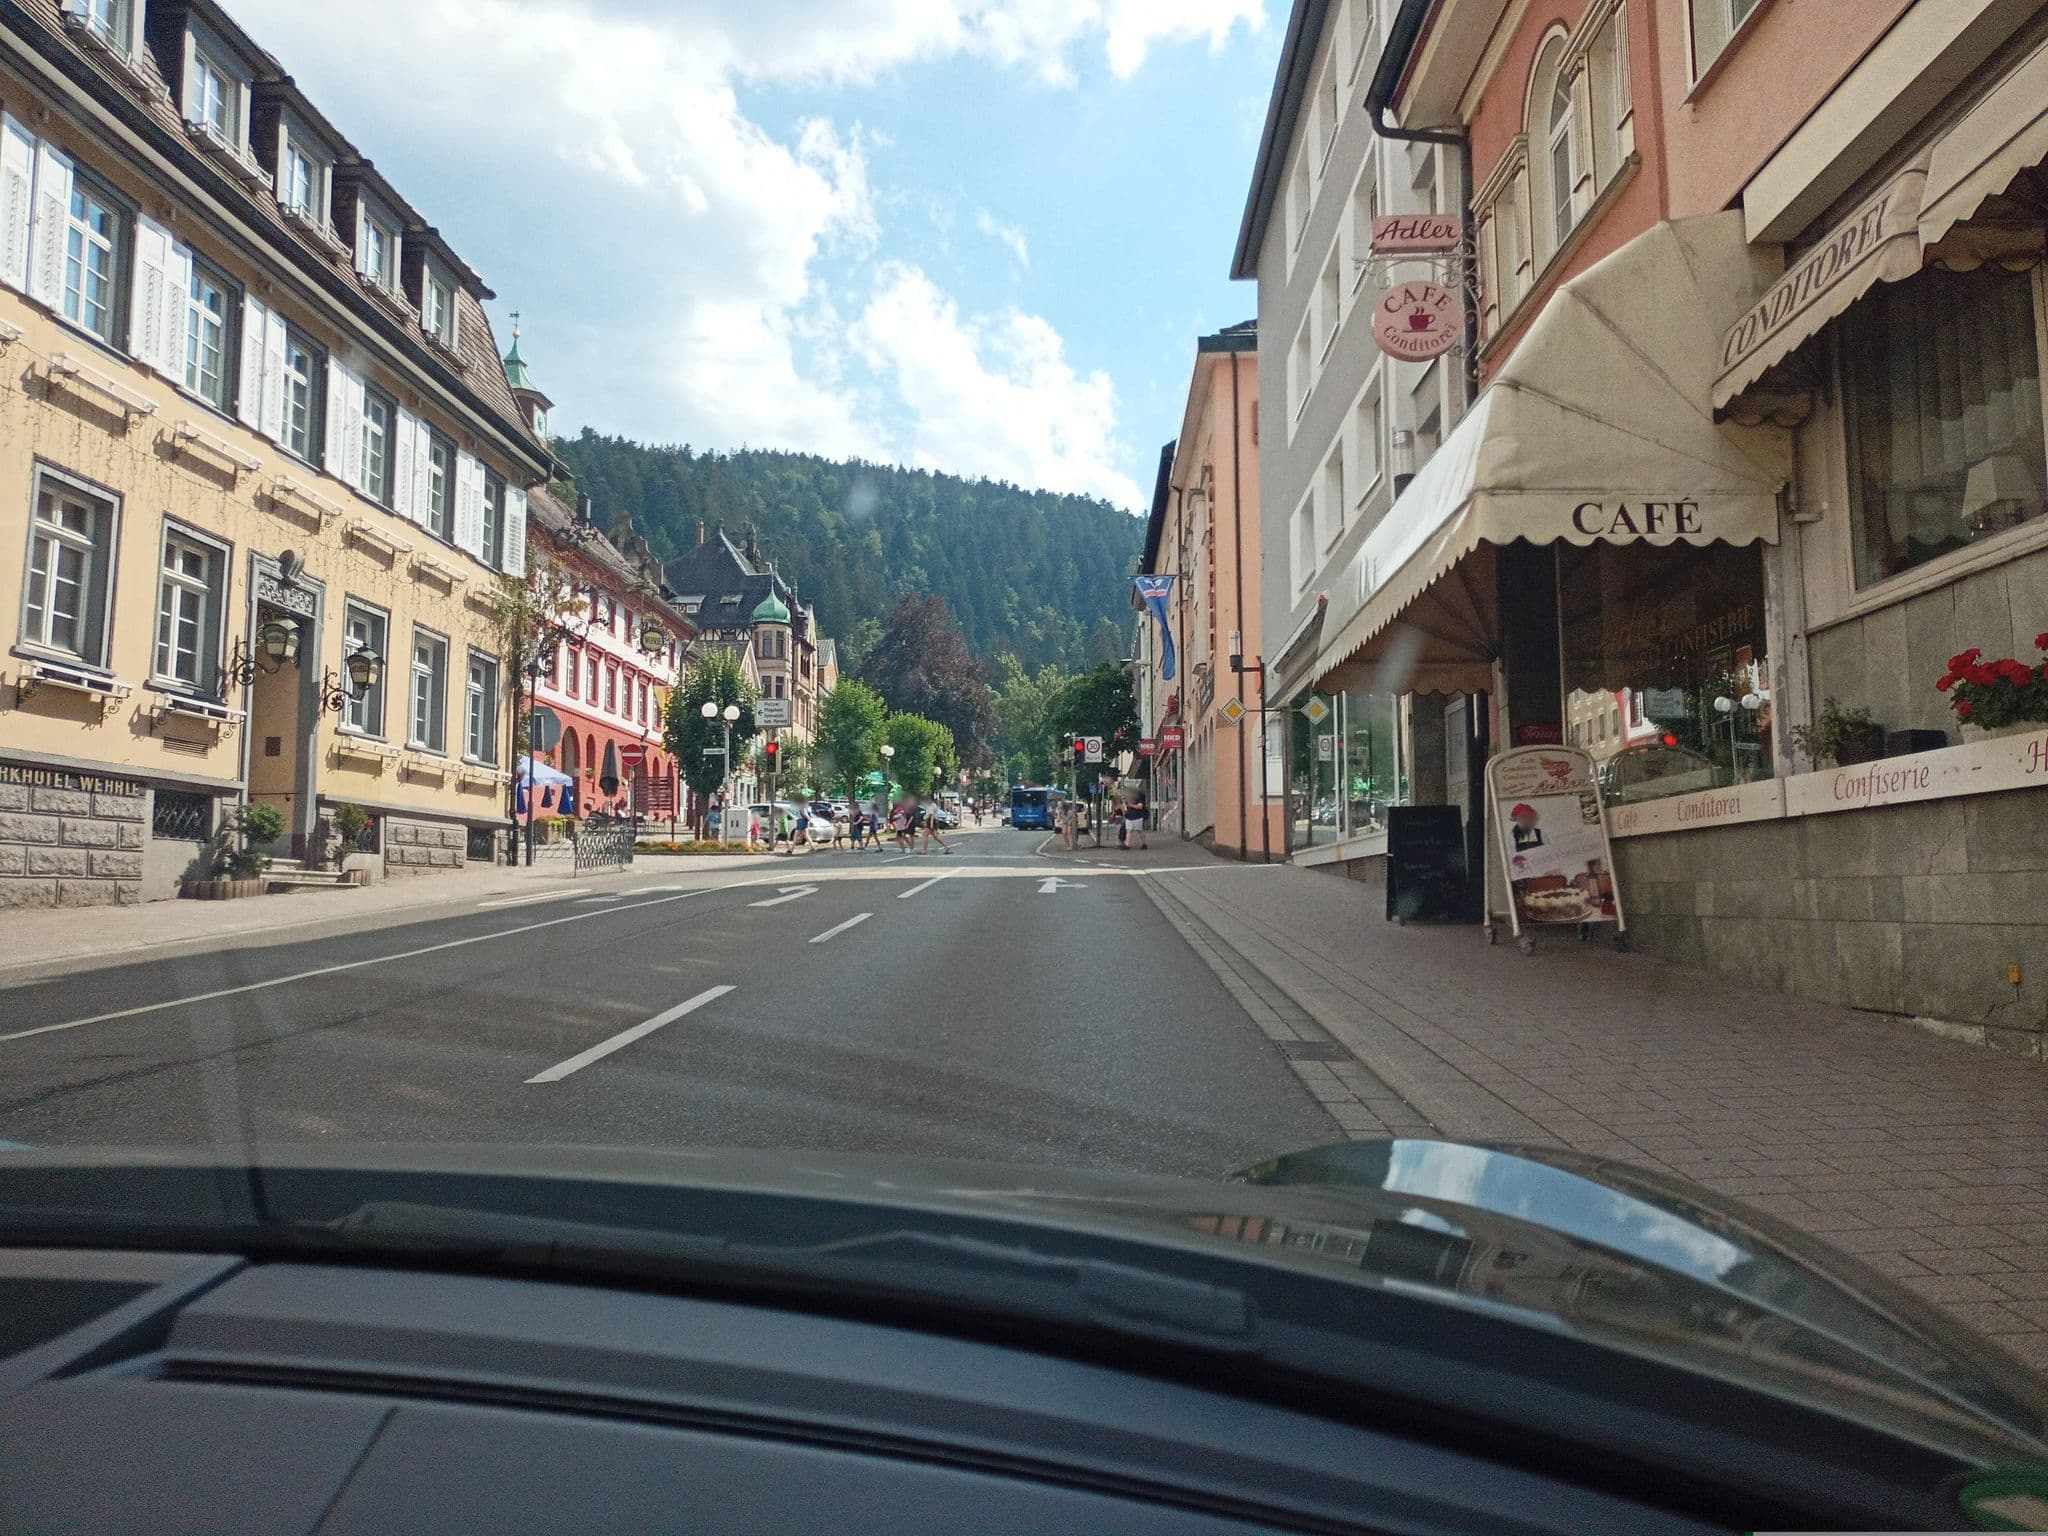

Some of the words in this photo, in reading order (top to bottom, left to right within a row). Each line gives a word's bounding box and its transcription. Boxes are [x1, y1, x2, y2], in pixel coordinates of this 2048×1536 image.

[1376, 219, 1458, 241] Adler
[1723, 193, 1893, 368] CONDITOREI
[1384, 286, 1452, 314] CAFE
[1383, 322, 1457, 352] Conditorei
[1572, 496, 1703, 535] CAFÉ
[1163, 734, 1181, 742] NKD
[79, 775, 141, 797] WEHRLE
[1676, 791, 1742, 822] Conditorei
[1833, 760, 1931, 801] Confiserie
